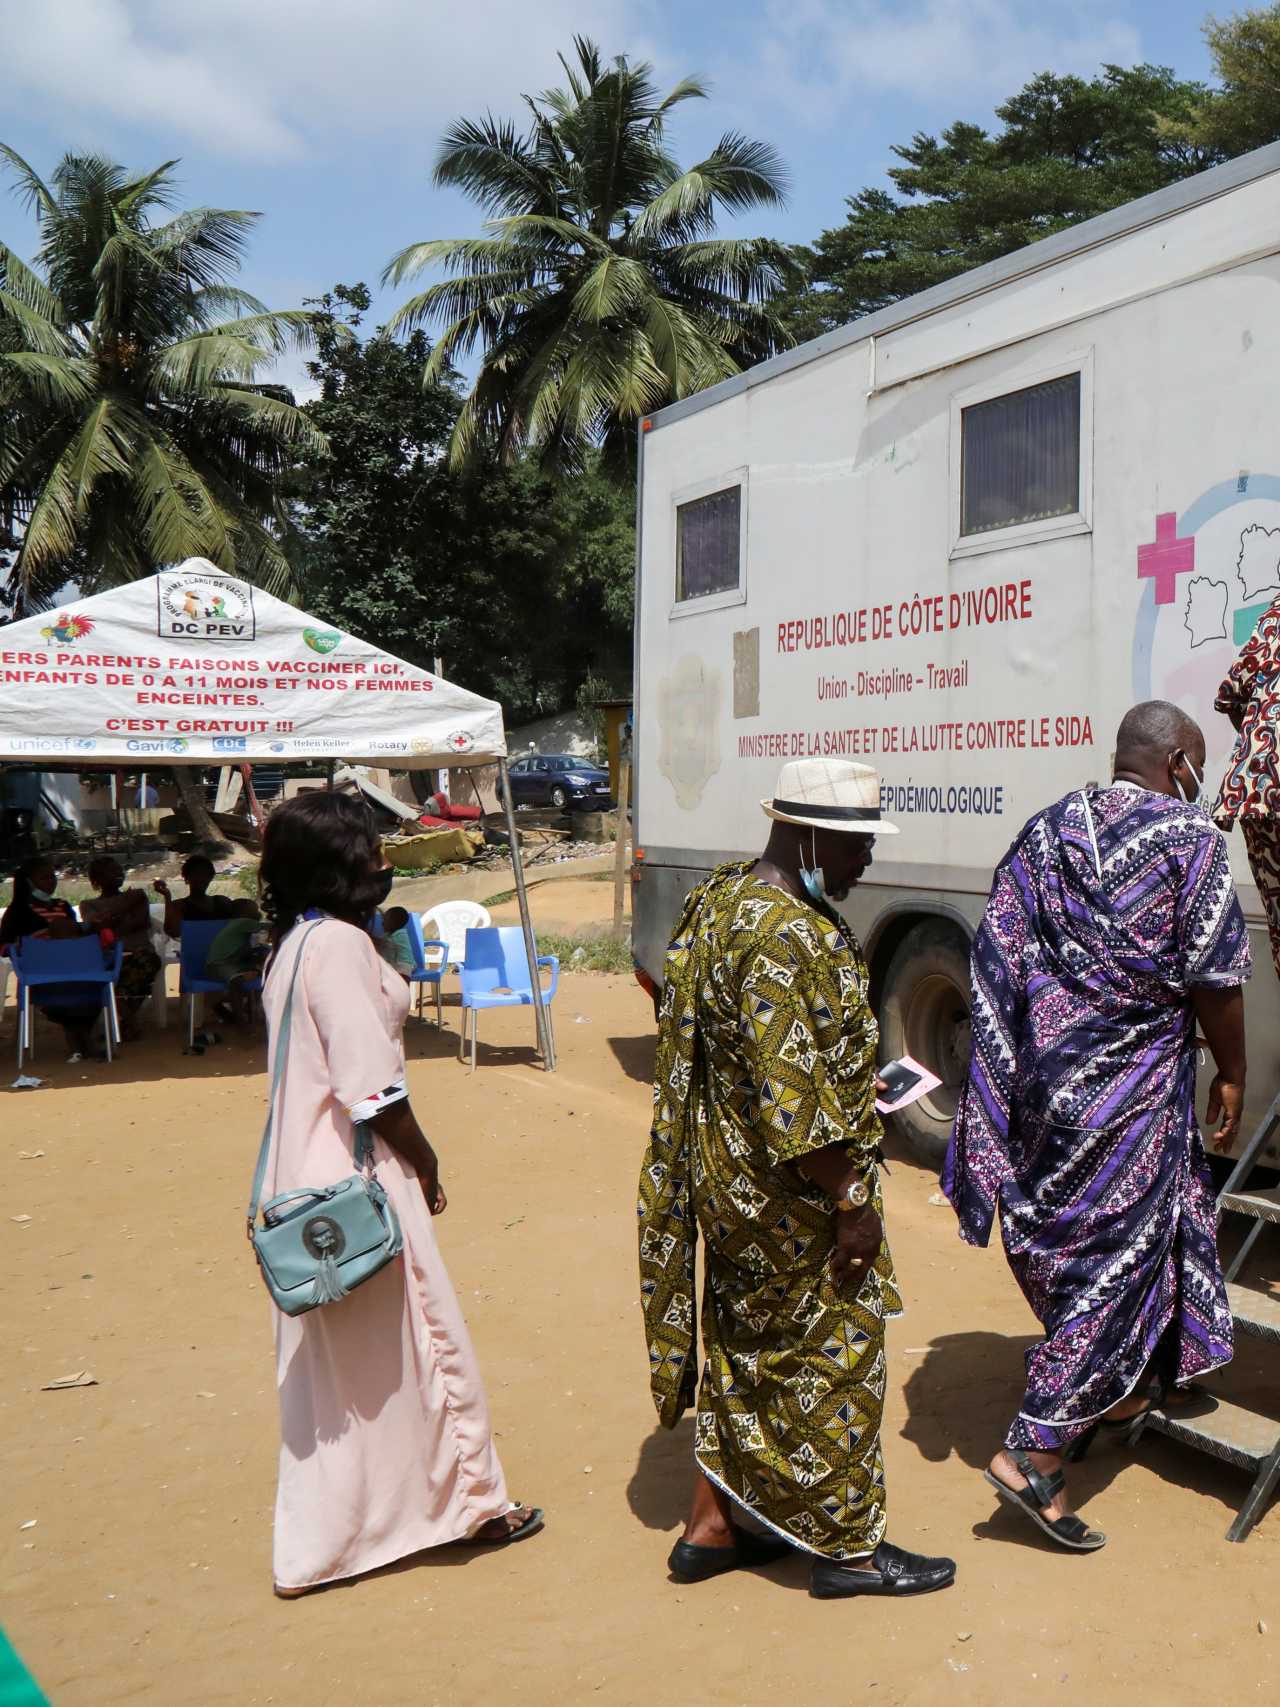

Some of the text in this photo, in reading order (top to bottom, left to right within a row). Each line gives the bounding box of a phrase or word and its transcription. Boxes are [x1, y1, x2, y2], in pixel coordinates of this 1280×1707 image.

[171, 622, 245, 636] DC PEV
[777, 609, 867, 653] REPUBLIQUE
[872, 604, 893, 640] DE
[898, 592, 944, 637] CÔTE
[56, 653, 161, 669] PARENTS
[169, 658, 260, 672] FAISONS
[267, 661, 366, 674] VACCINER
[373, 664, 405, 676] ICI,
[106, 674, 135, 686] DE
[142, 675, 154, 687] 0
[162, 676, 177, 688] A
[185, 677, 207, 688] 11
[216, 677, 268, 689] MOIS
[275, 679, 300, 690] ET
[307, 680, 349, 691] NOS
[355, 680, 434, 692] FEMMES
[817, 674, 848, 701] Union
[857, 665, 913, 700] Discipline
[927, 659, 968, 690] Travail
[136, 692, 265, 706] ENCEINTES.
[176, 720, 269, 732] GRATUIT
[276, 721, 293, 732] !!!
[10, 736, 71, 751] unicef
[127, 737, 164, 752] Gavi
[738, 715, 1093, 758] MINISTERE DE LA SANTE ET DE LA LUTTE CONTRE LE SIDA
[369, 741, 408, 751] Rotary
[879, 777, 1003, 816] ÉPIDÉMIOLOGIQUE
